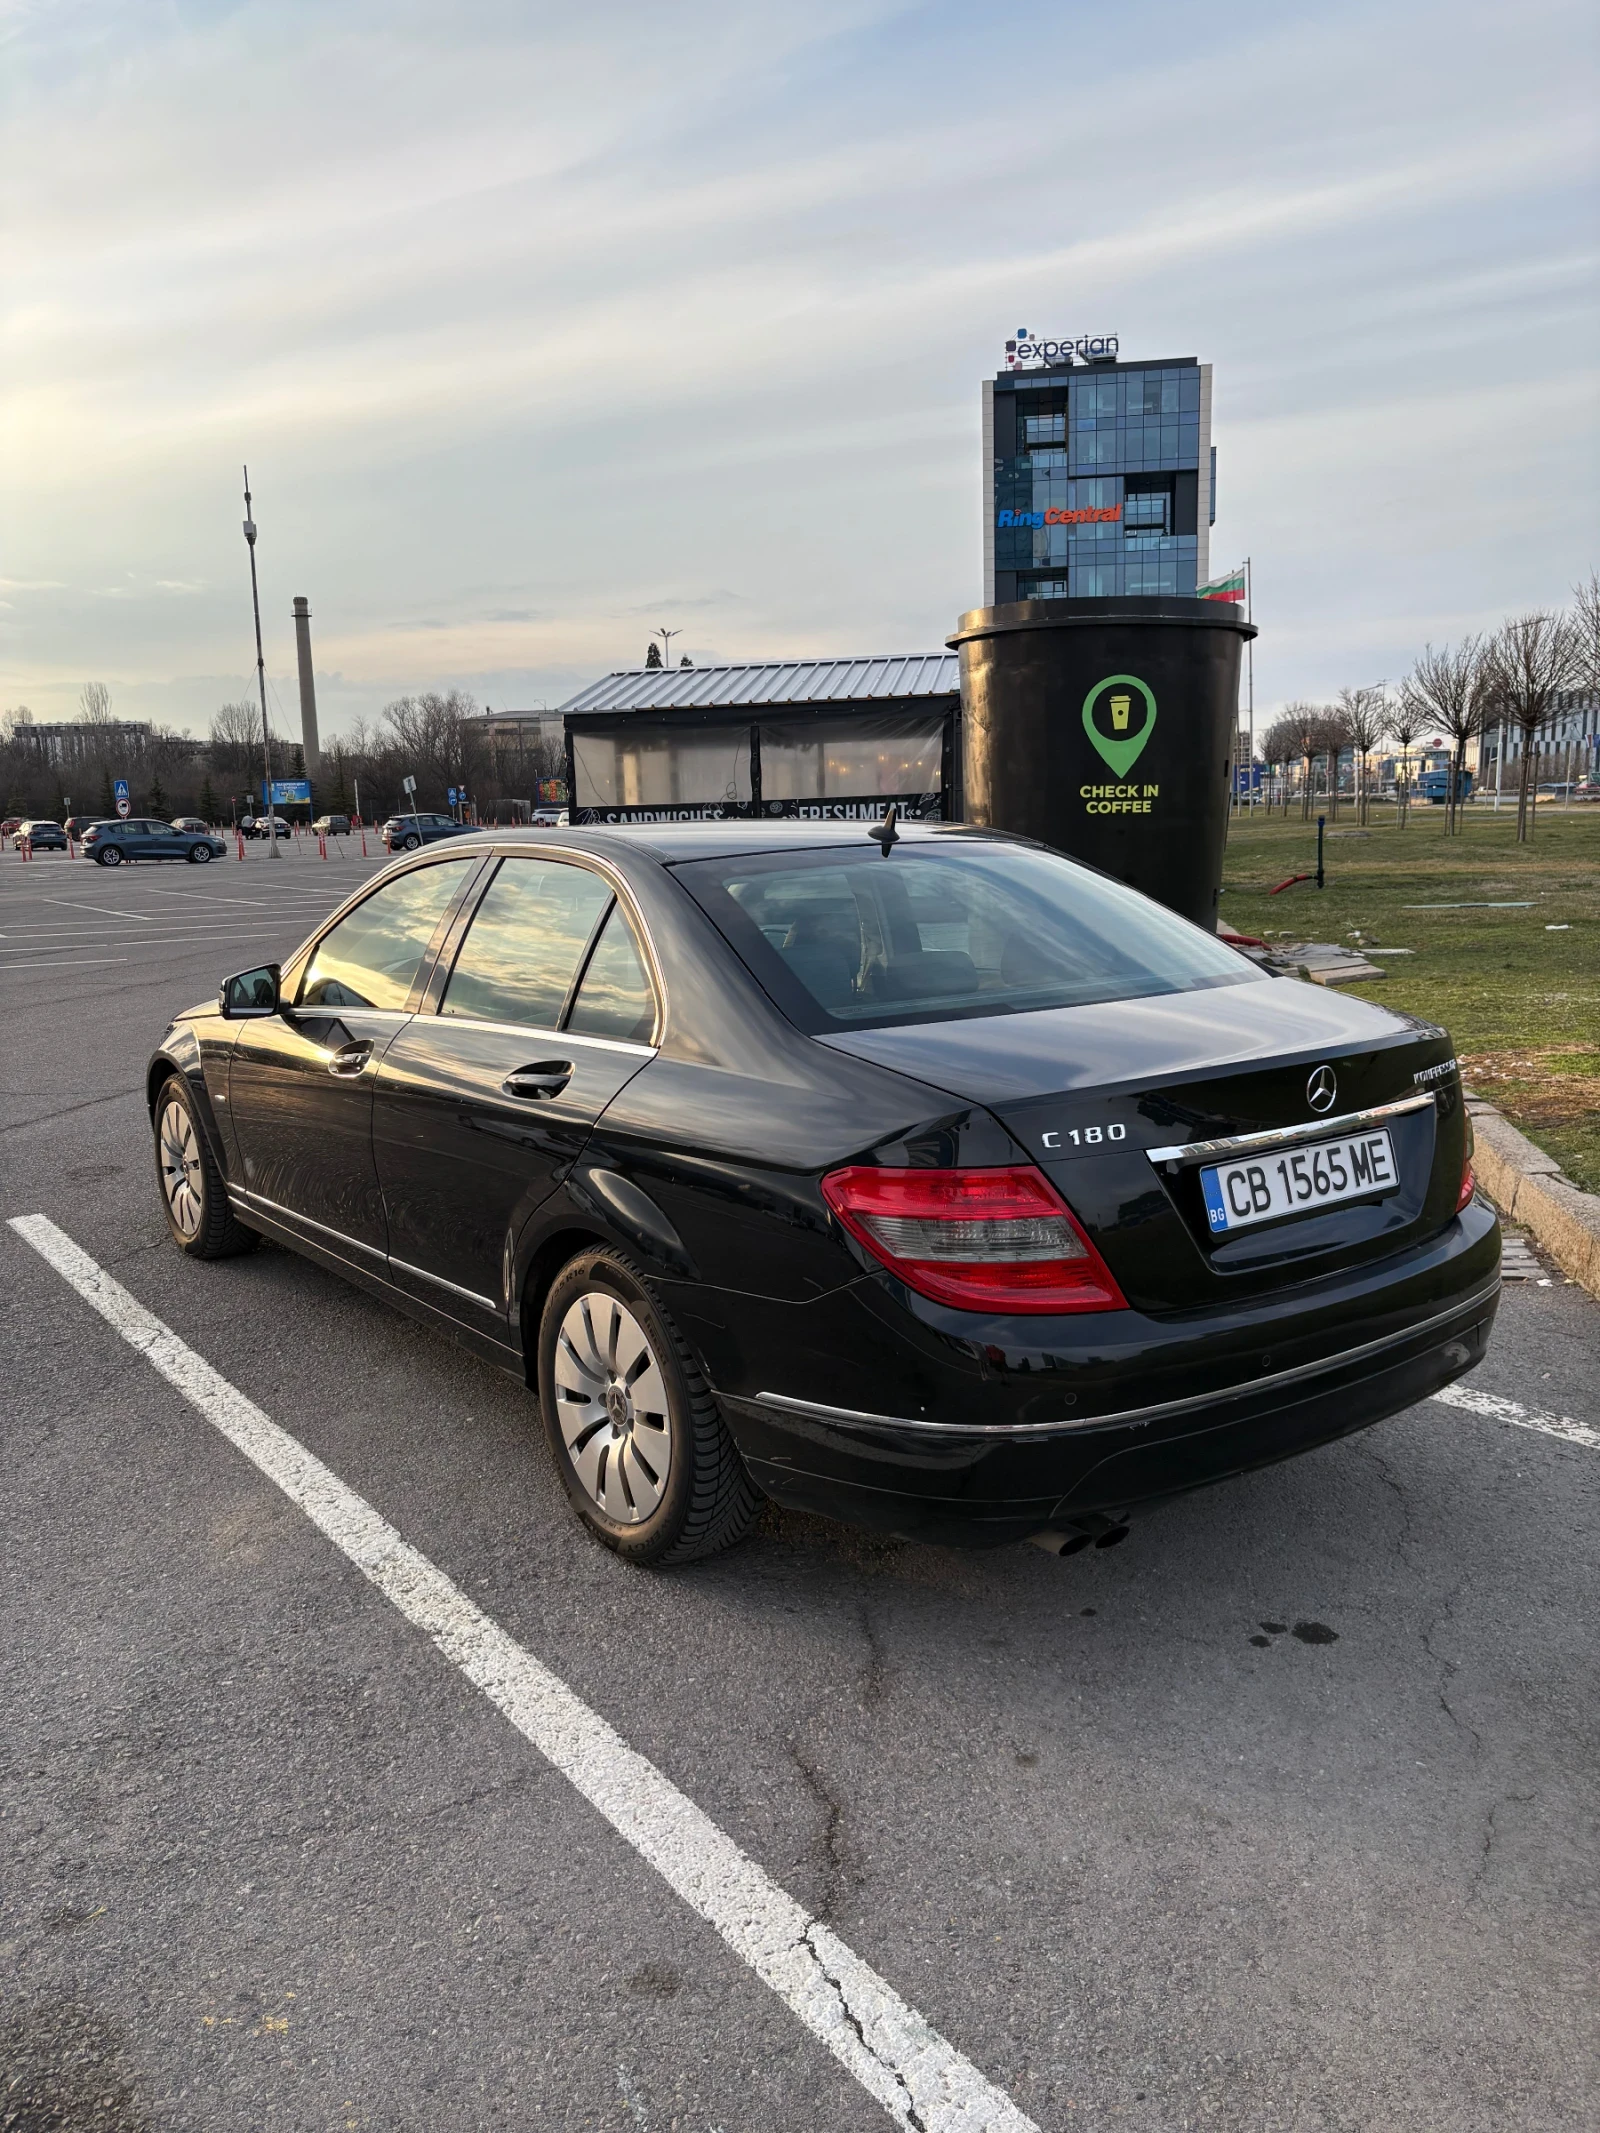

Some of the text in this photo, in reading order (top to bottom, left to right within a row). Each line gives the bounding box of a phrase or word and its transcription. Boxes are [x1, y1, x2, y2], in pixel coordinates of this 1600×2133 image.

[1017, 335, 1119, 361] experian
[998, 504, 1121, 529] RingCentral
[1079, 784, 1159, 798] CHECK IN
[1085, 801, 1152, 814] COFFEE
[1042, 1123, 1126, 1148] C 180
[1227, 1138, 1391, 1218] CB 1565 ME
[1209, 1207, 1225, 1224] BG
